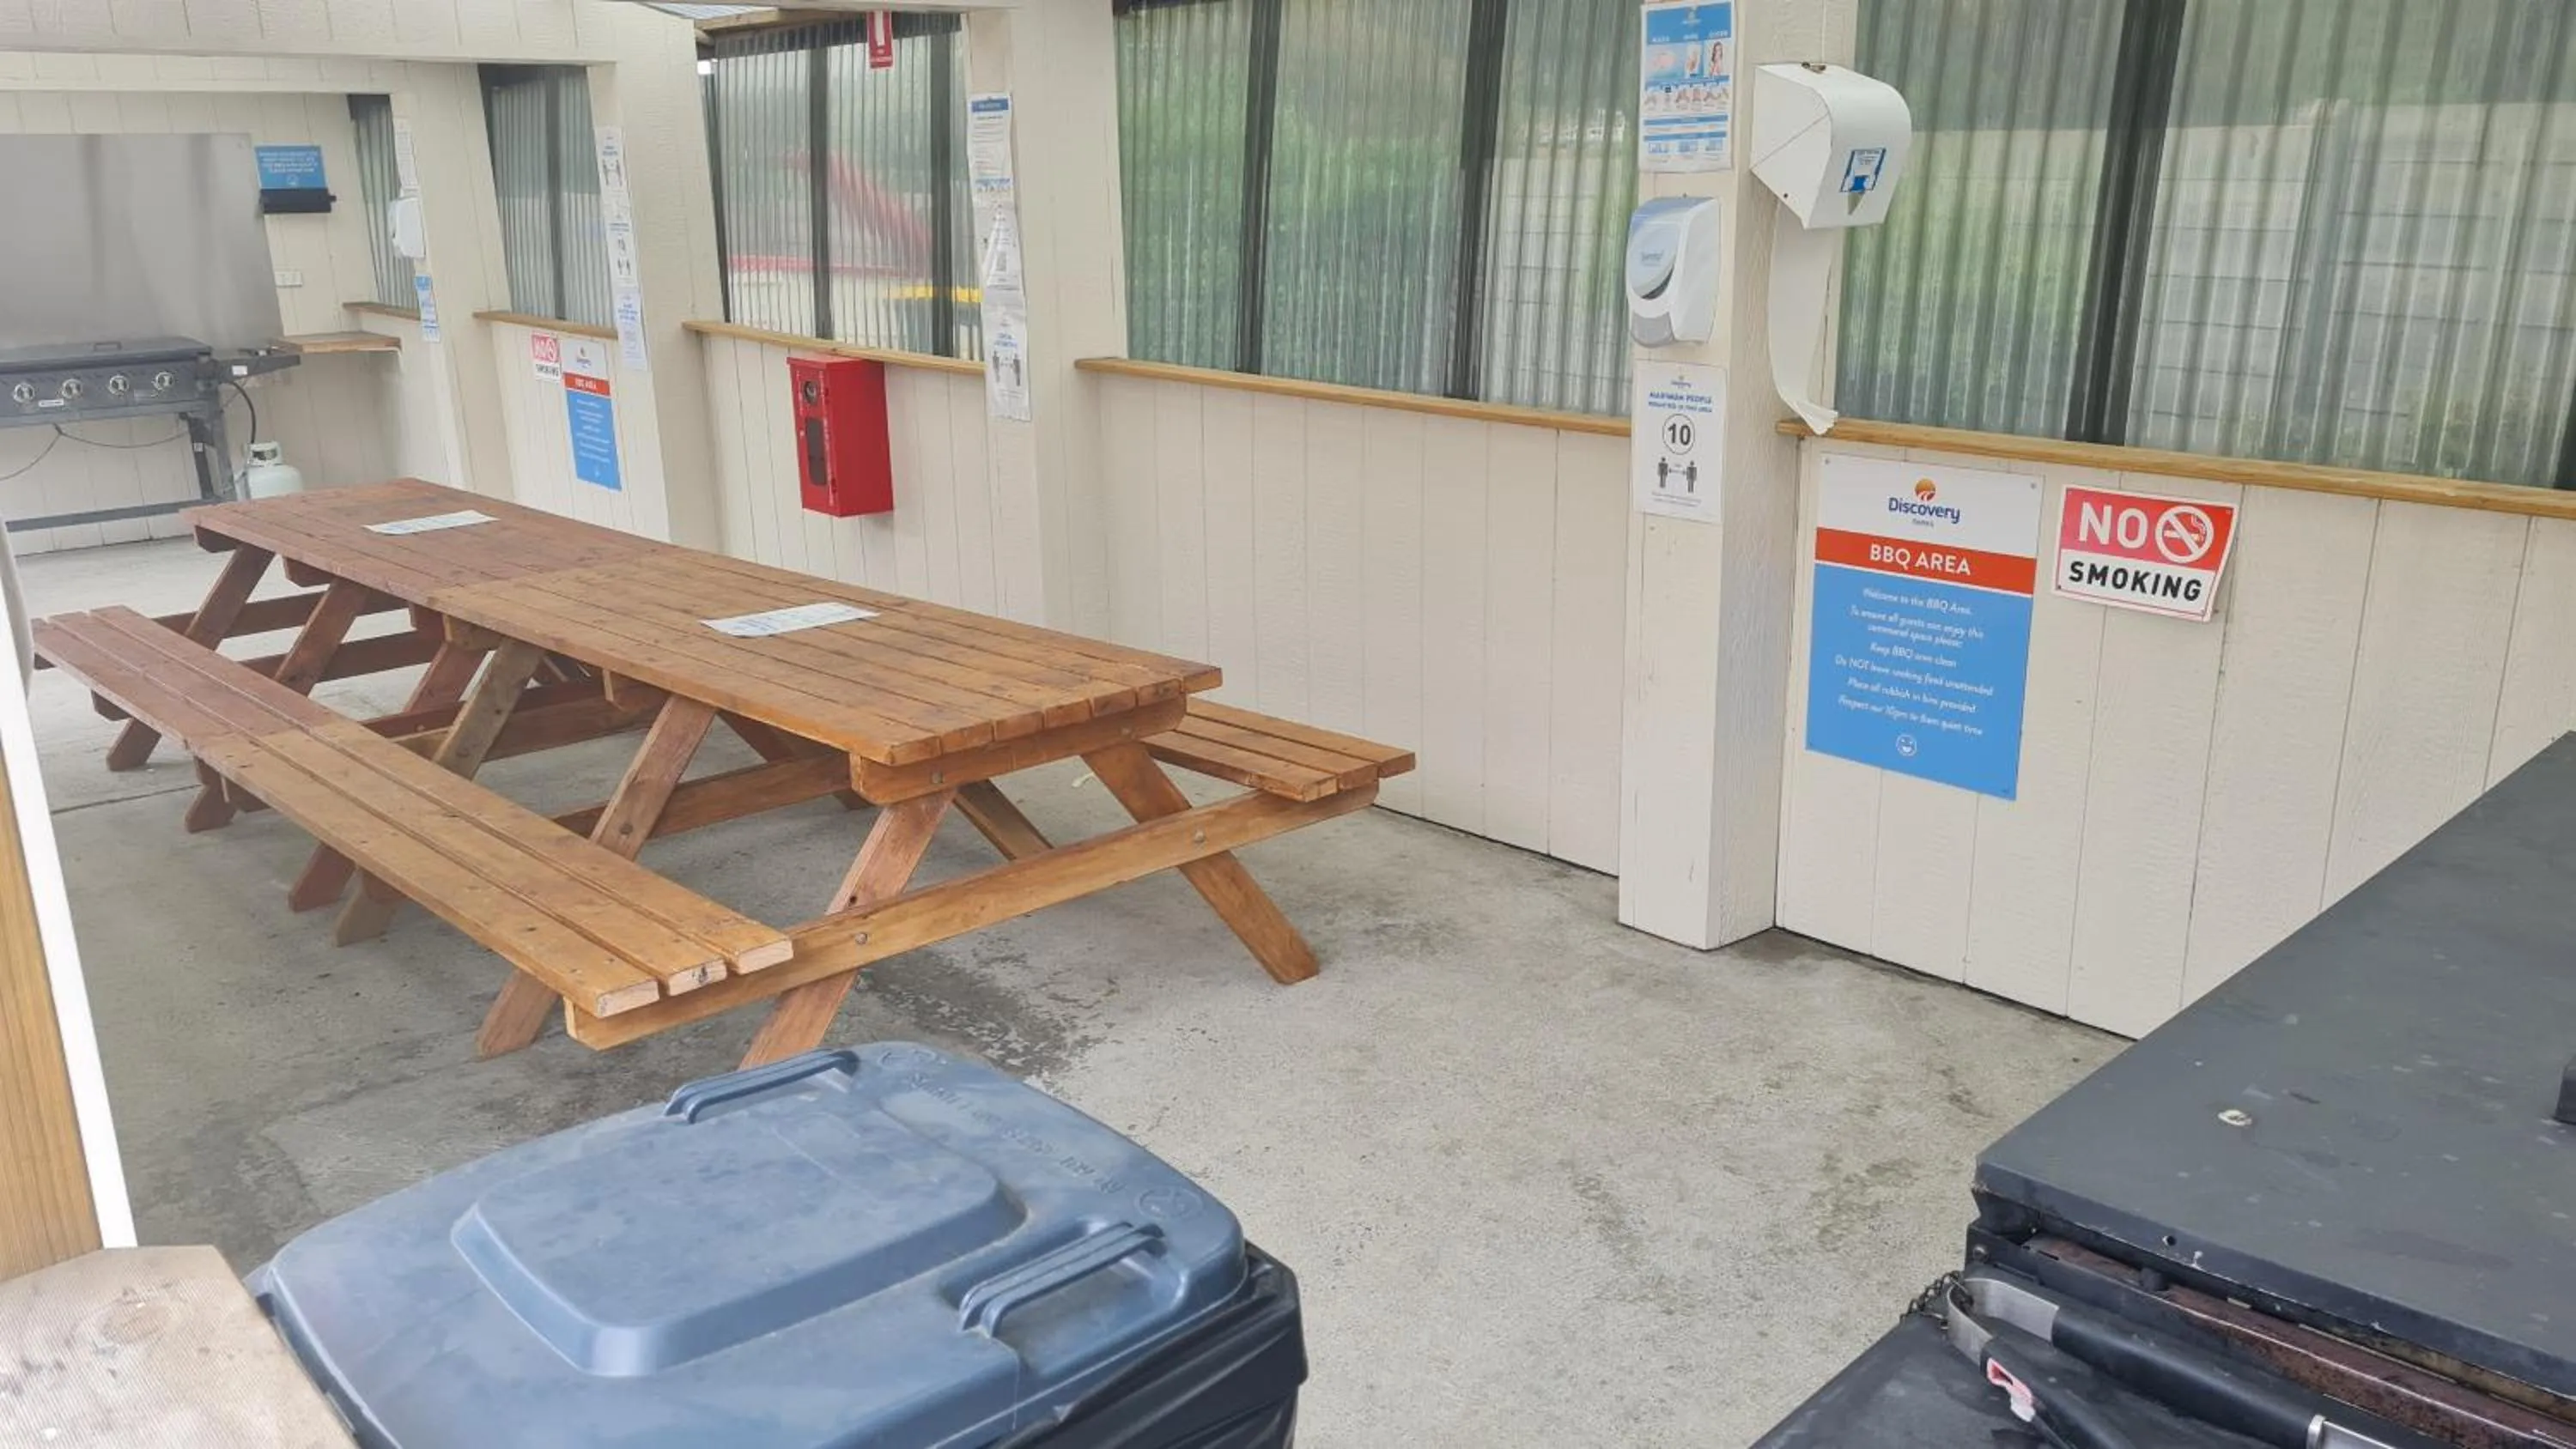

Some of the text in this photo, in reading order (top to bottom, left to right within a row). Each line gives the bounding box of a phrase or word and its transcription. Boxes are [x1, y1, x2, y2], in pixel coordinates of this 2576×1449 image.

[1667, 422, 1692, 446] 10
[1887, 496, 1961, 524] Discovery
[2078, 500, 2148, 549] NO
[1869, 543, 1971, 577] BBQ AREA
[2068, 560, 2202, 602] SMOKING
[1926, 597, 1948, 615] BBQ
[1848, 657, 1869, 670] NOT
[1892, 645, 1915, 659] BBQ
